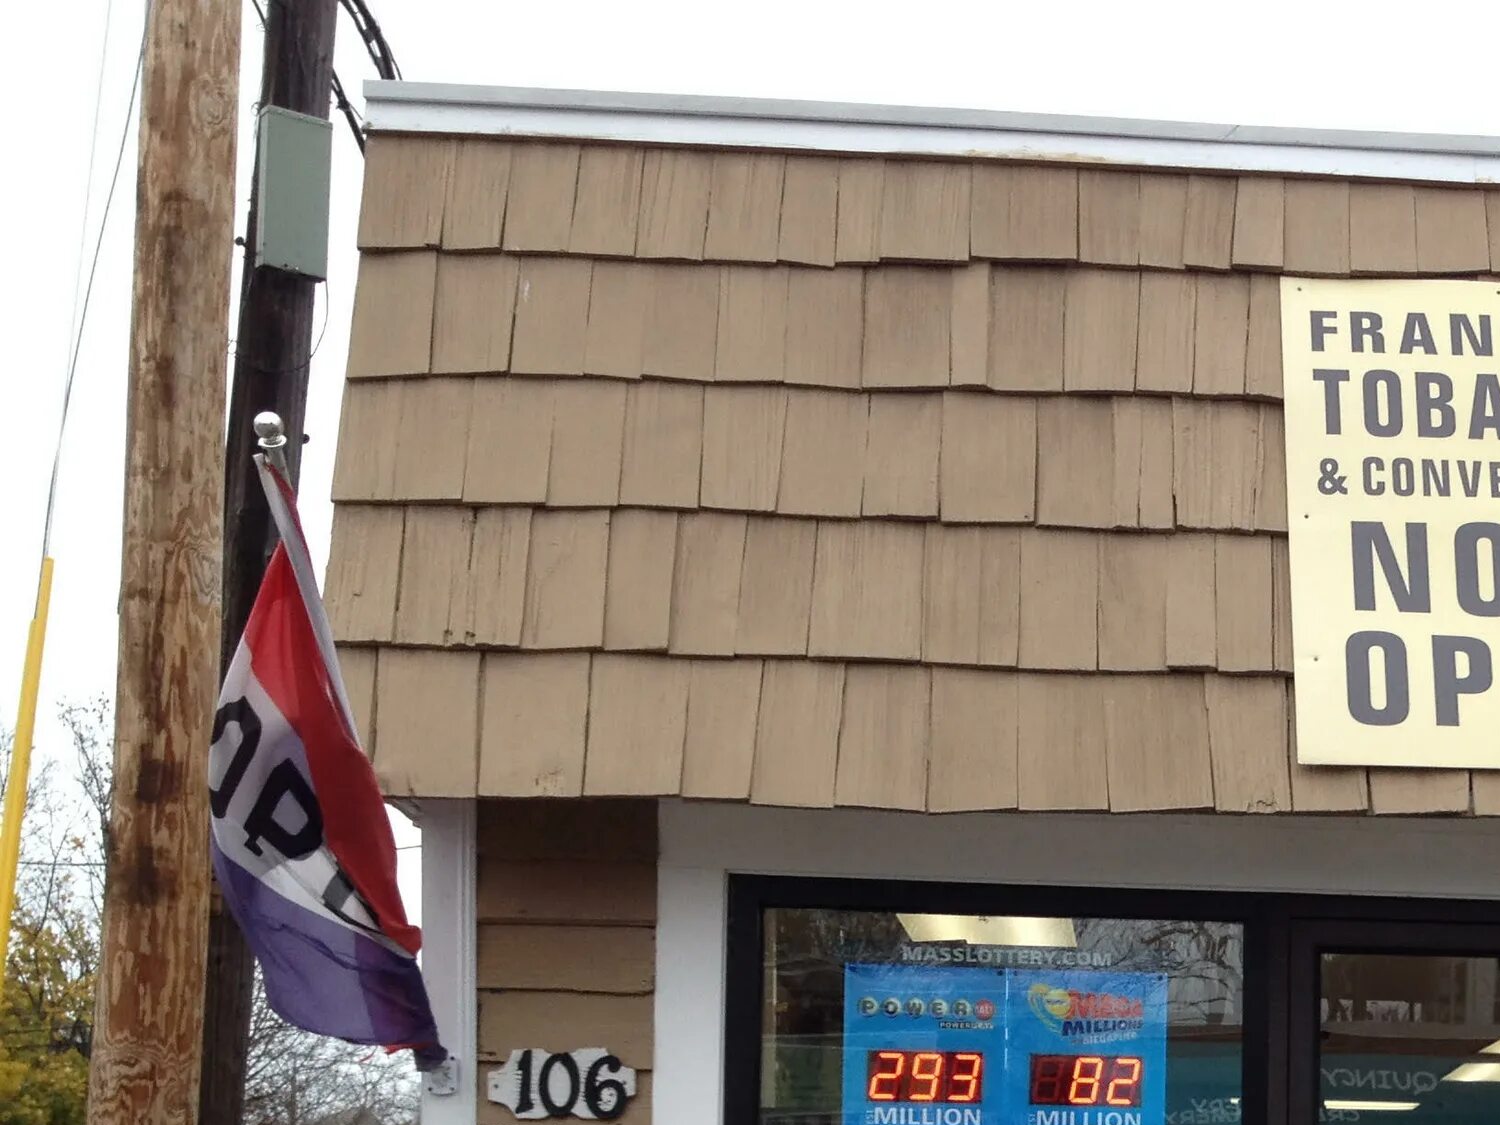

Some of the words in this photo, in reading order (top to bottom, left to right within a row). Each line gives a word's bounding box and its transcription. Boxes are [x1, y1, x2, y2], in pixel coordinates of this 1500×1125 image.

[1317, 457, 1348, 496] &
[901, 946, 1112, 967] MASSLOTTERY.COM
[1062, 1019, 1143, 1036] MILLIONS
[515, 1050, 628, 1120] 106
[868, 1052, 981, 1101] 293
[1068, 1056, 1143, 1106] 82
